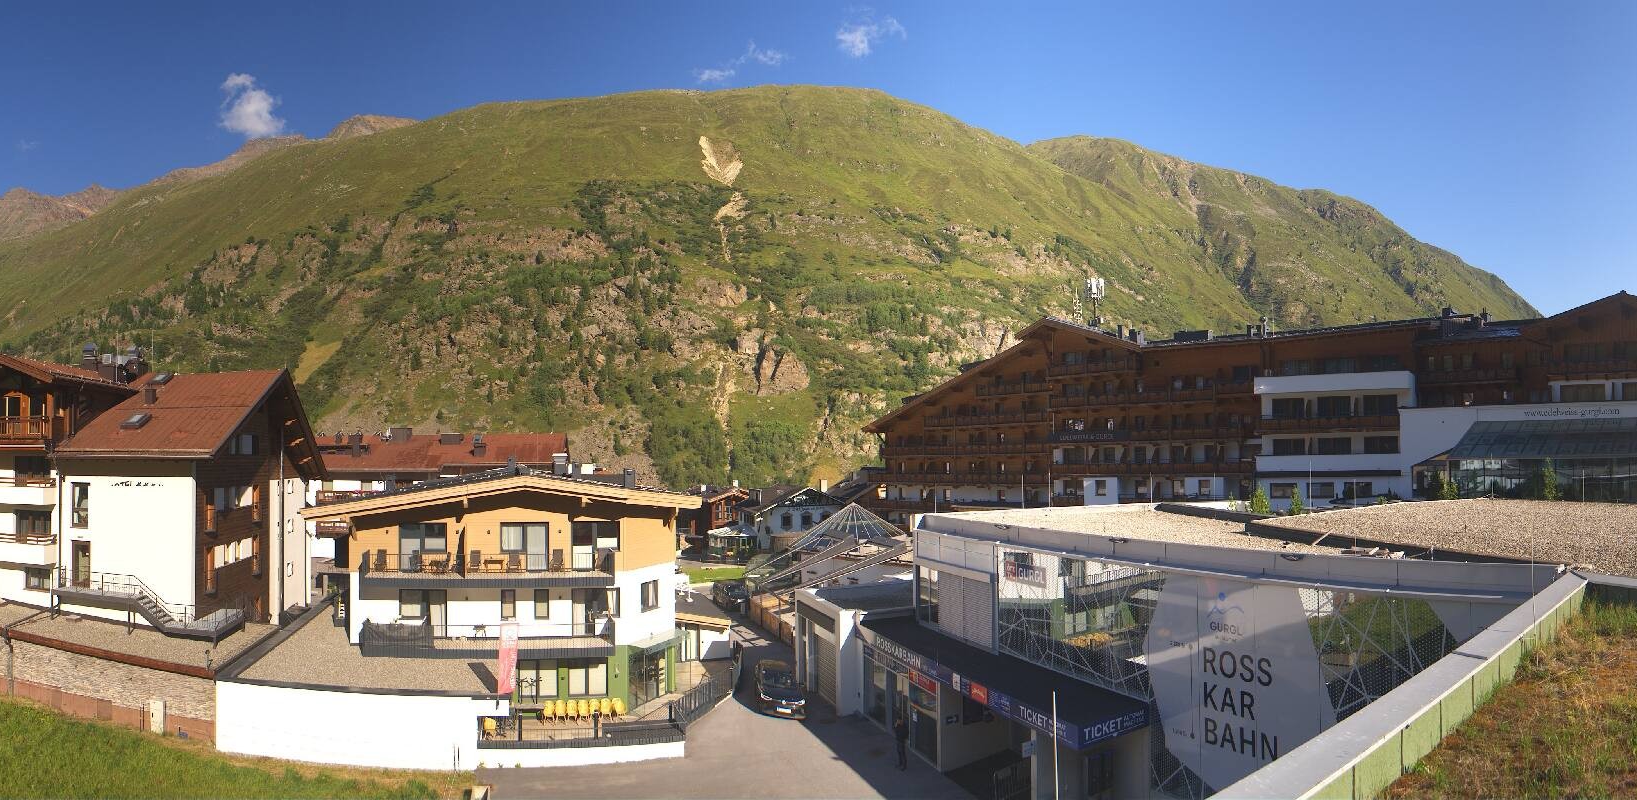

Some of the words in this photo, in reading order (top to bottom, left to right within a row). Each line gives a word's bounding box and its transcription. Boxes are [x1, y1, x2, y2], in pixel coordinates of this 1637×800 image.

[1018, 567, 1045, 584] GURGL
[1209, 621, 1243, 636] GURGL
[876, 635, 921, 669] ROSSKARBAHN
[1204, 647, 1272, 687] ROSS
[1204, 682, 1255, 720] KAR
[1019, 705, 1048, 728] TICKET
[1084, 717, 1122, 740] TICKET
[1204, 717, 1278, 761] BAHN
